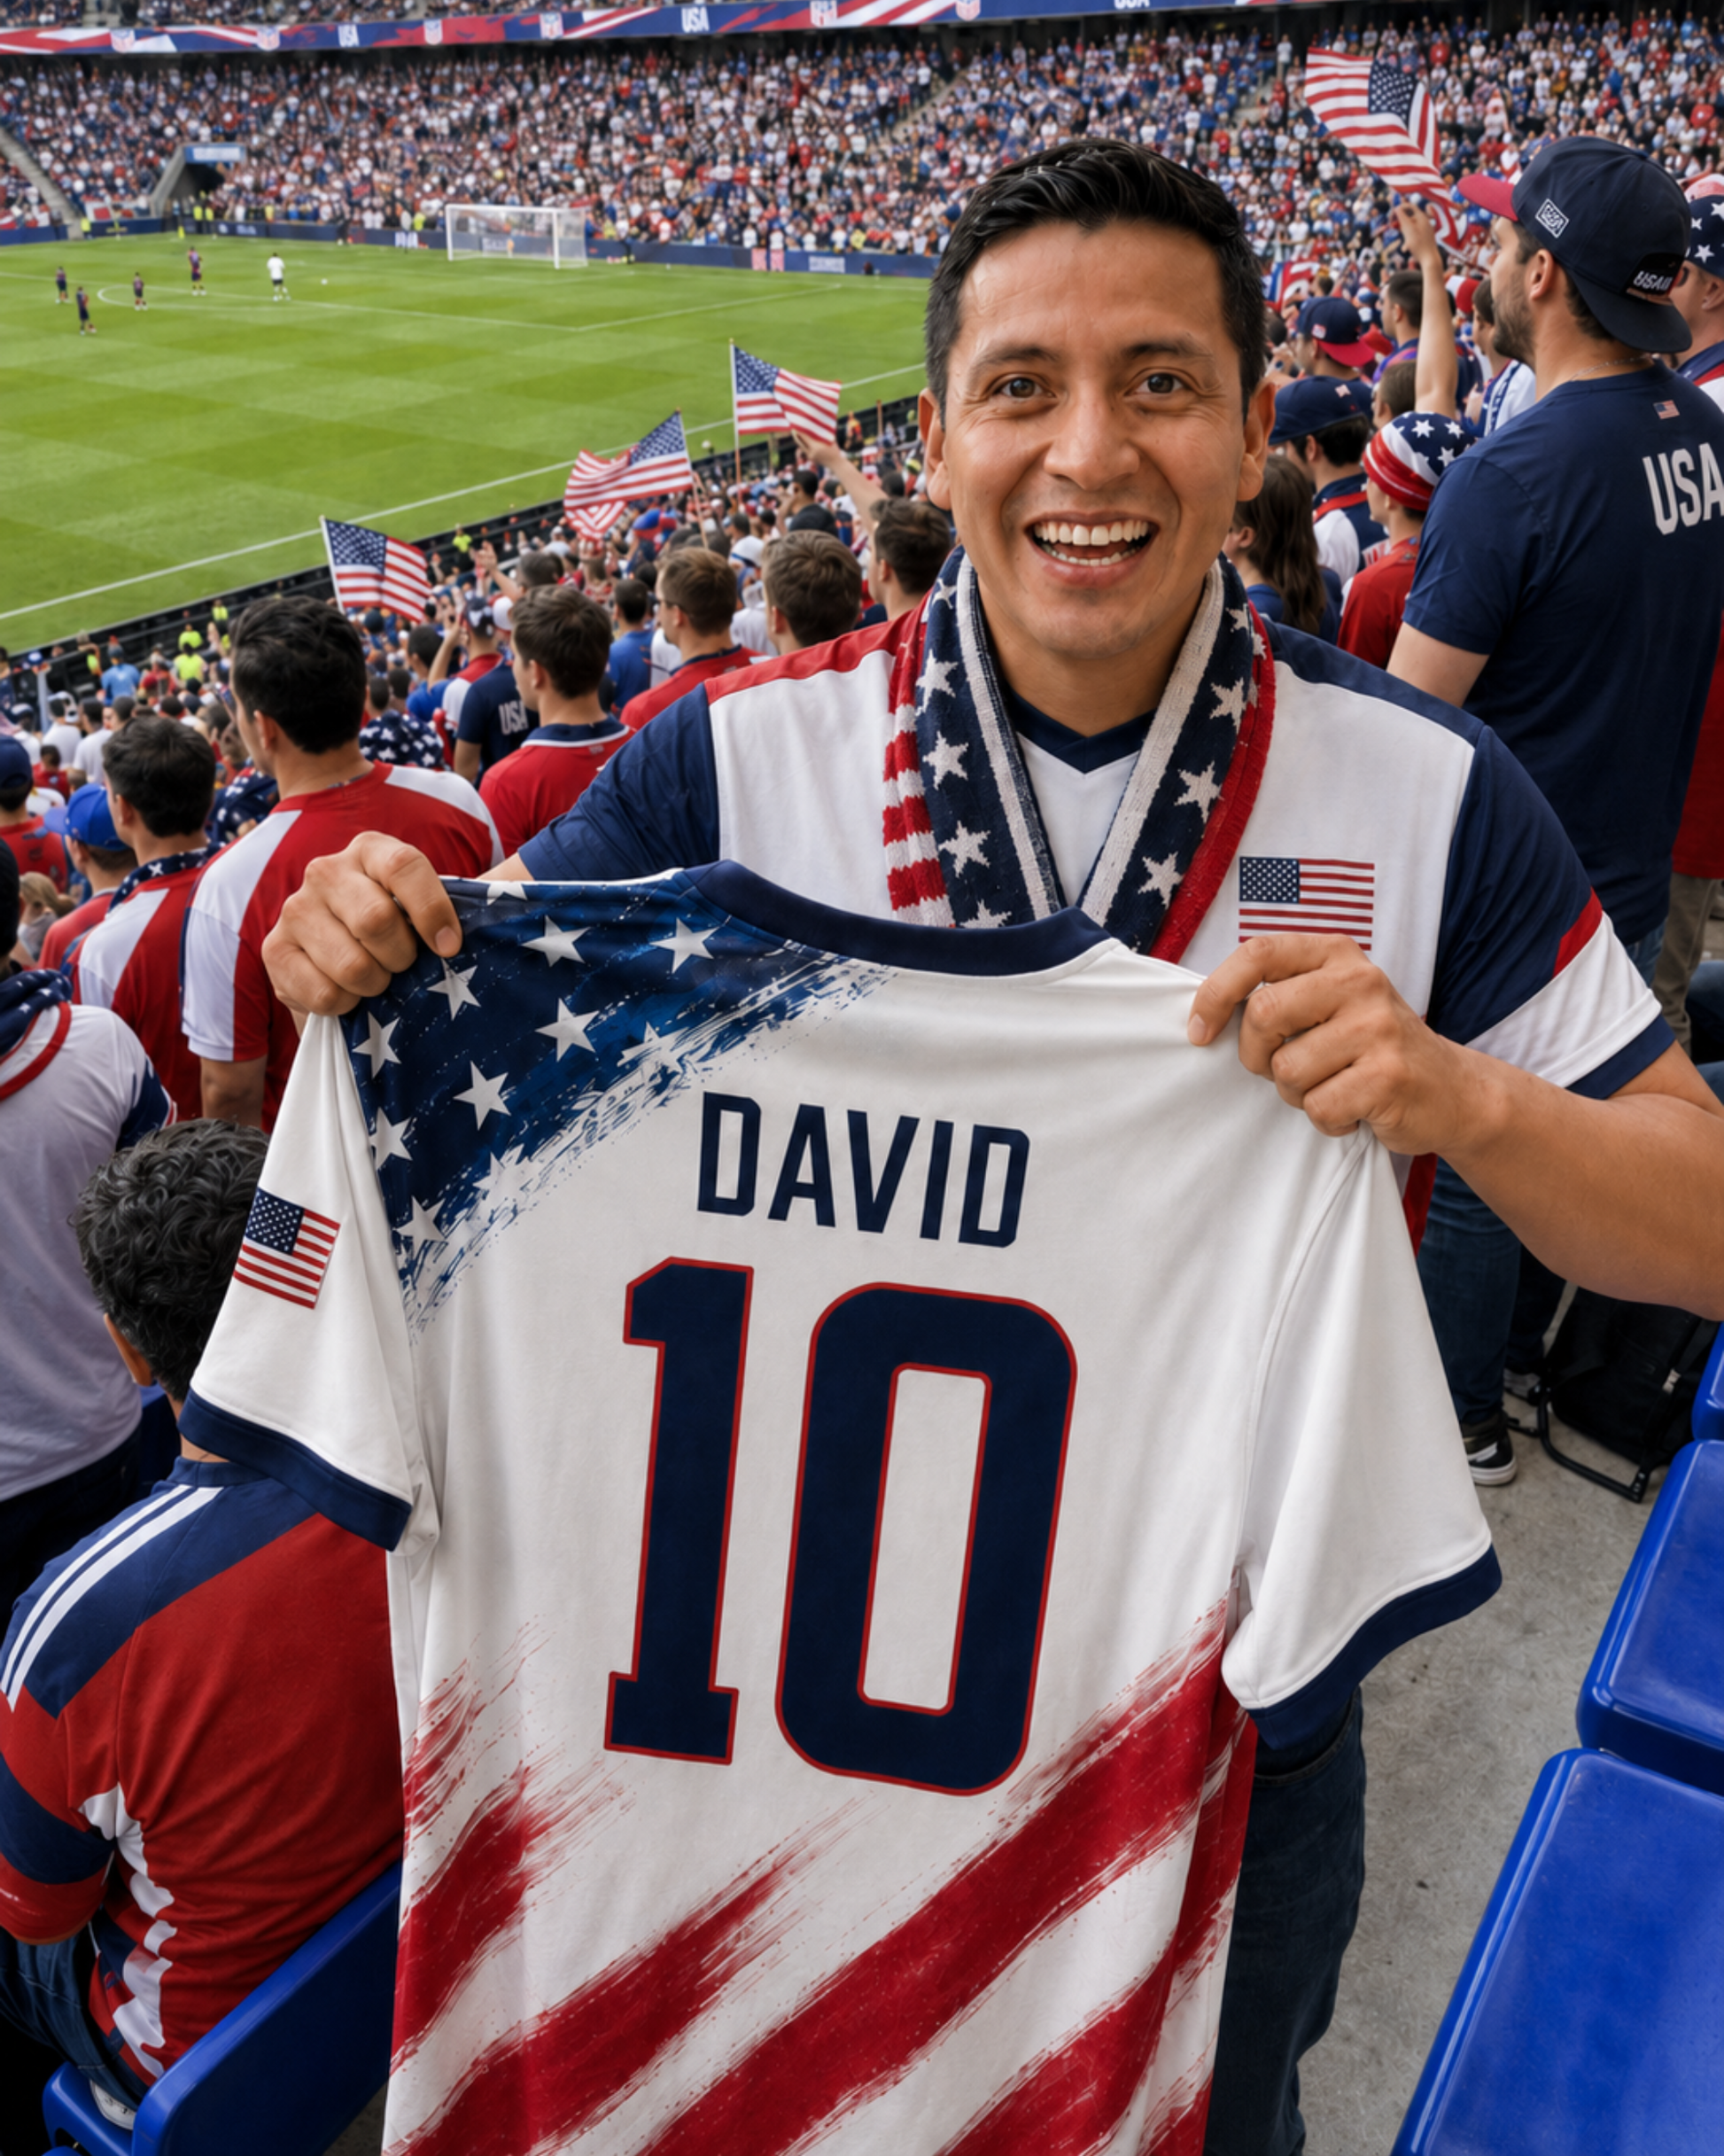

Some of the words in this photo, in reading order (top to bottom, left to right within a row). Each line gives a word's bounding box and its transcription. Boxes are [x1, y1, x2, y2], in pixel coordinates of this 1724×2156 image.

[681, 6, 710, 33] USA
[1642, 441, 1724, 535] USA
[499, 700, 529, 736] USA
[697, 1091, 1030, 1249] DAVID
[603, 1255, 1078, 1797] 10
